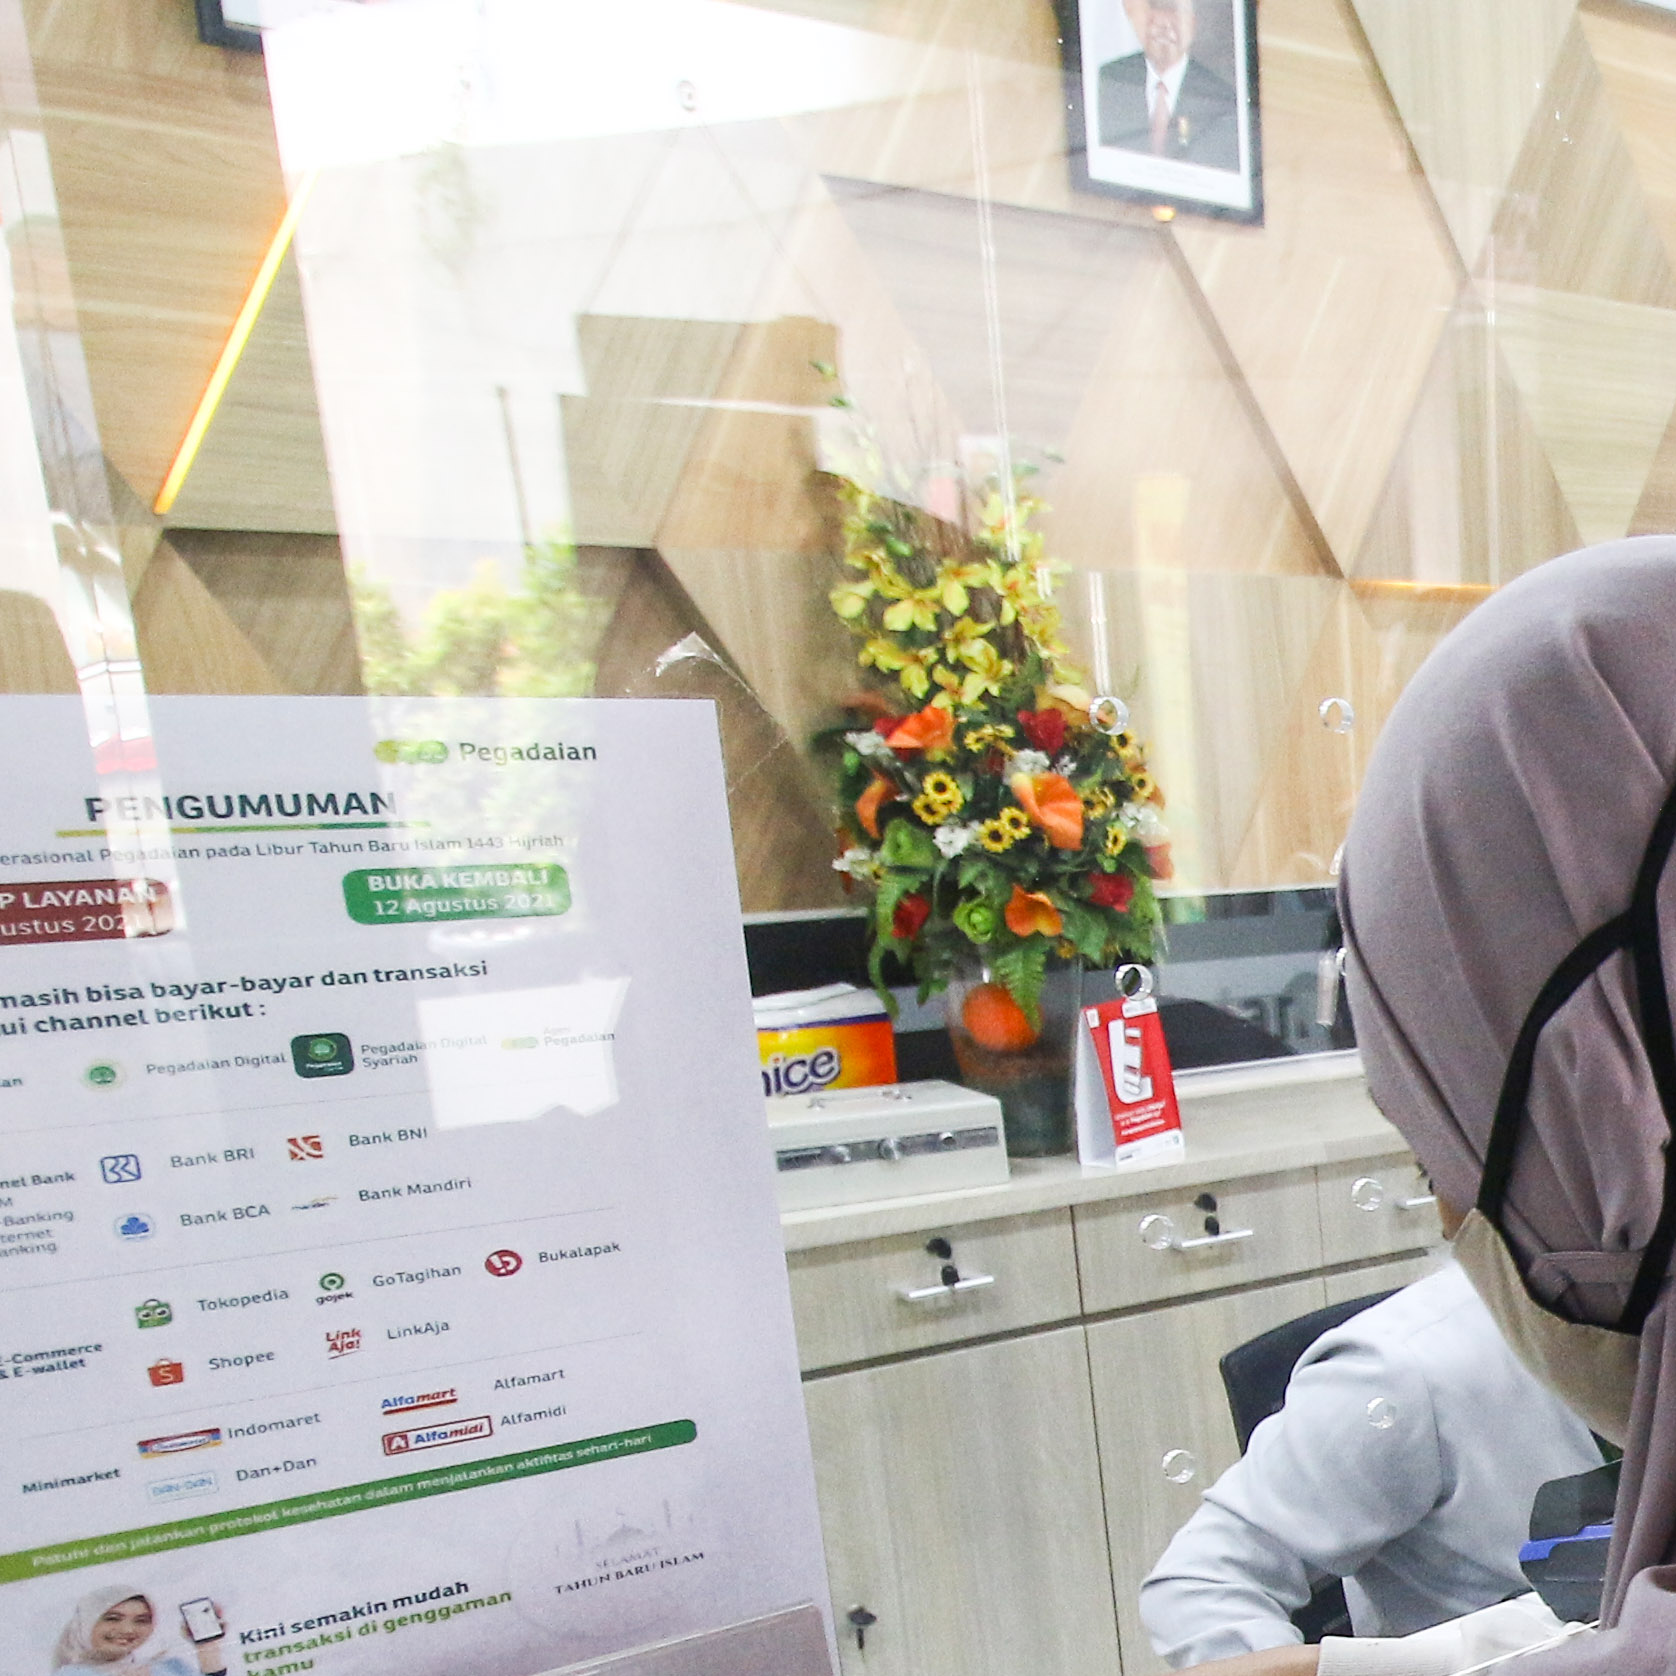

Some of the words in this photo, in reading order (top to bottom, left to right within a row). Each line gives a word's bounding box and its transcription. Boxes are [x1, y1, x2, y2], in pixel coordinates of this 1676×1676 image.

[459, 742, 597, 766] Pegadaian
[84, 792, 396, 822] PENGUMUMAN
[101, 847, 200, 866] Pegadaian
[206, 844, 251, 860] pada
[256, 842, 304, 856] Libur
[309, 840, 363, 854] Tahun
[369, 839, 409, 853] Baru
[415, 837, 461, 851] Islam
[466, 836, 504, 849] 1443
[509, 834, 564, 852] Hijriah
[367, 872, 437, 892] BUKA
[443, 868, 549, 889] KEMBALI
[23, 887, 157, 909] LAYANAN
[374, 899, 398, 916] 12
[405, 896, 498, 918] Agustus
[503, 894, 554, 910] 2021
[86, 985, 145, 1003] bisa
[150, 975, 315, 1001] bayar-bayar
[321, 969, 368, 987] dan
[373, 960, 488, 984] transaksi
[29, 1009, 149, 1033] channel
[155, 1002, 254, 1026] berikut
[360, 1038, 437, 1057] Pegadaian
[441, 1034, 488, 1050] Digital
[544, 1032, 616, 1048] Pegadaian
[146, 1057, 230, 1077] Pegadaian
[235, 1053, 287, 1071] Digital
[362, 1053, 418, 1070] Syariah
[762, 1049, 838, 1097] ice
[349, 1131, 393, 1147] Bank
[397, 1127, 428, 1142] BNI
[170, 1151, 217, 1168] Bank
[224, 1148, 255, 1164] BRI
[31, 1171, 75, 1186] Bank
[358, 1185, 403, 1202] Bank
[407, 1176, 472, 1196] Mandiri
[180, 1209, 227, 1227] Bank
[234, 1203, 271, 1222] BCA
[538, 1241, 622, 1264] Bukalapak
[373, 1263, 462, 1288] GoTagihan
[197, 1288, 289, 1312] Tokopedia
[325, 1328, 362, 1343] Link
[387, 1319, 450, 1341] LinkAja
[208, 1350, 276, 1371] Shopee
[494, 1368, 566, 1391] Alfamart
[381, 1387, 457, 1409] Alfamart
[227, 1412, 321, 1439] Indomaret
[500, 1404, 568, 1427] Alfamidi
[414, 1421, 484, 1446] Alfamidi
[22, 1466, 121, 1494] Minimarket
[236, 1457, 317, 1482] Dan+Dan
[208, 1509, 279, 1535] protokol
[281, 1493, 362, 1518] kesehatan
[365, 1483, 414, 1502] dalam
[417, 1463, 514, 1491] menjalankan
[576, 1433, 653, 1458] sehari-hari
[555, 1573, 610, 1594] TAHUN
[615, 1562, 656, 1581] BARU
[660, 1551, 705, 1570] ISLAM
[239, 1622, 287, 1646] Kini
[291, 1599, 386, 1634] semakin
[392, 1581, 470, 1610] mudah
[243, 1627, 352, 1665] transaksi
[358, 1618, 379, 1638] di
[384, 1590, 512, 1634] genggaman
